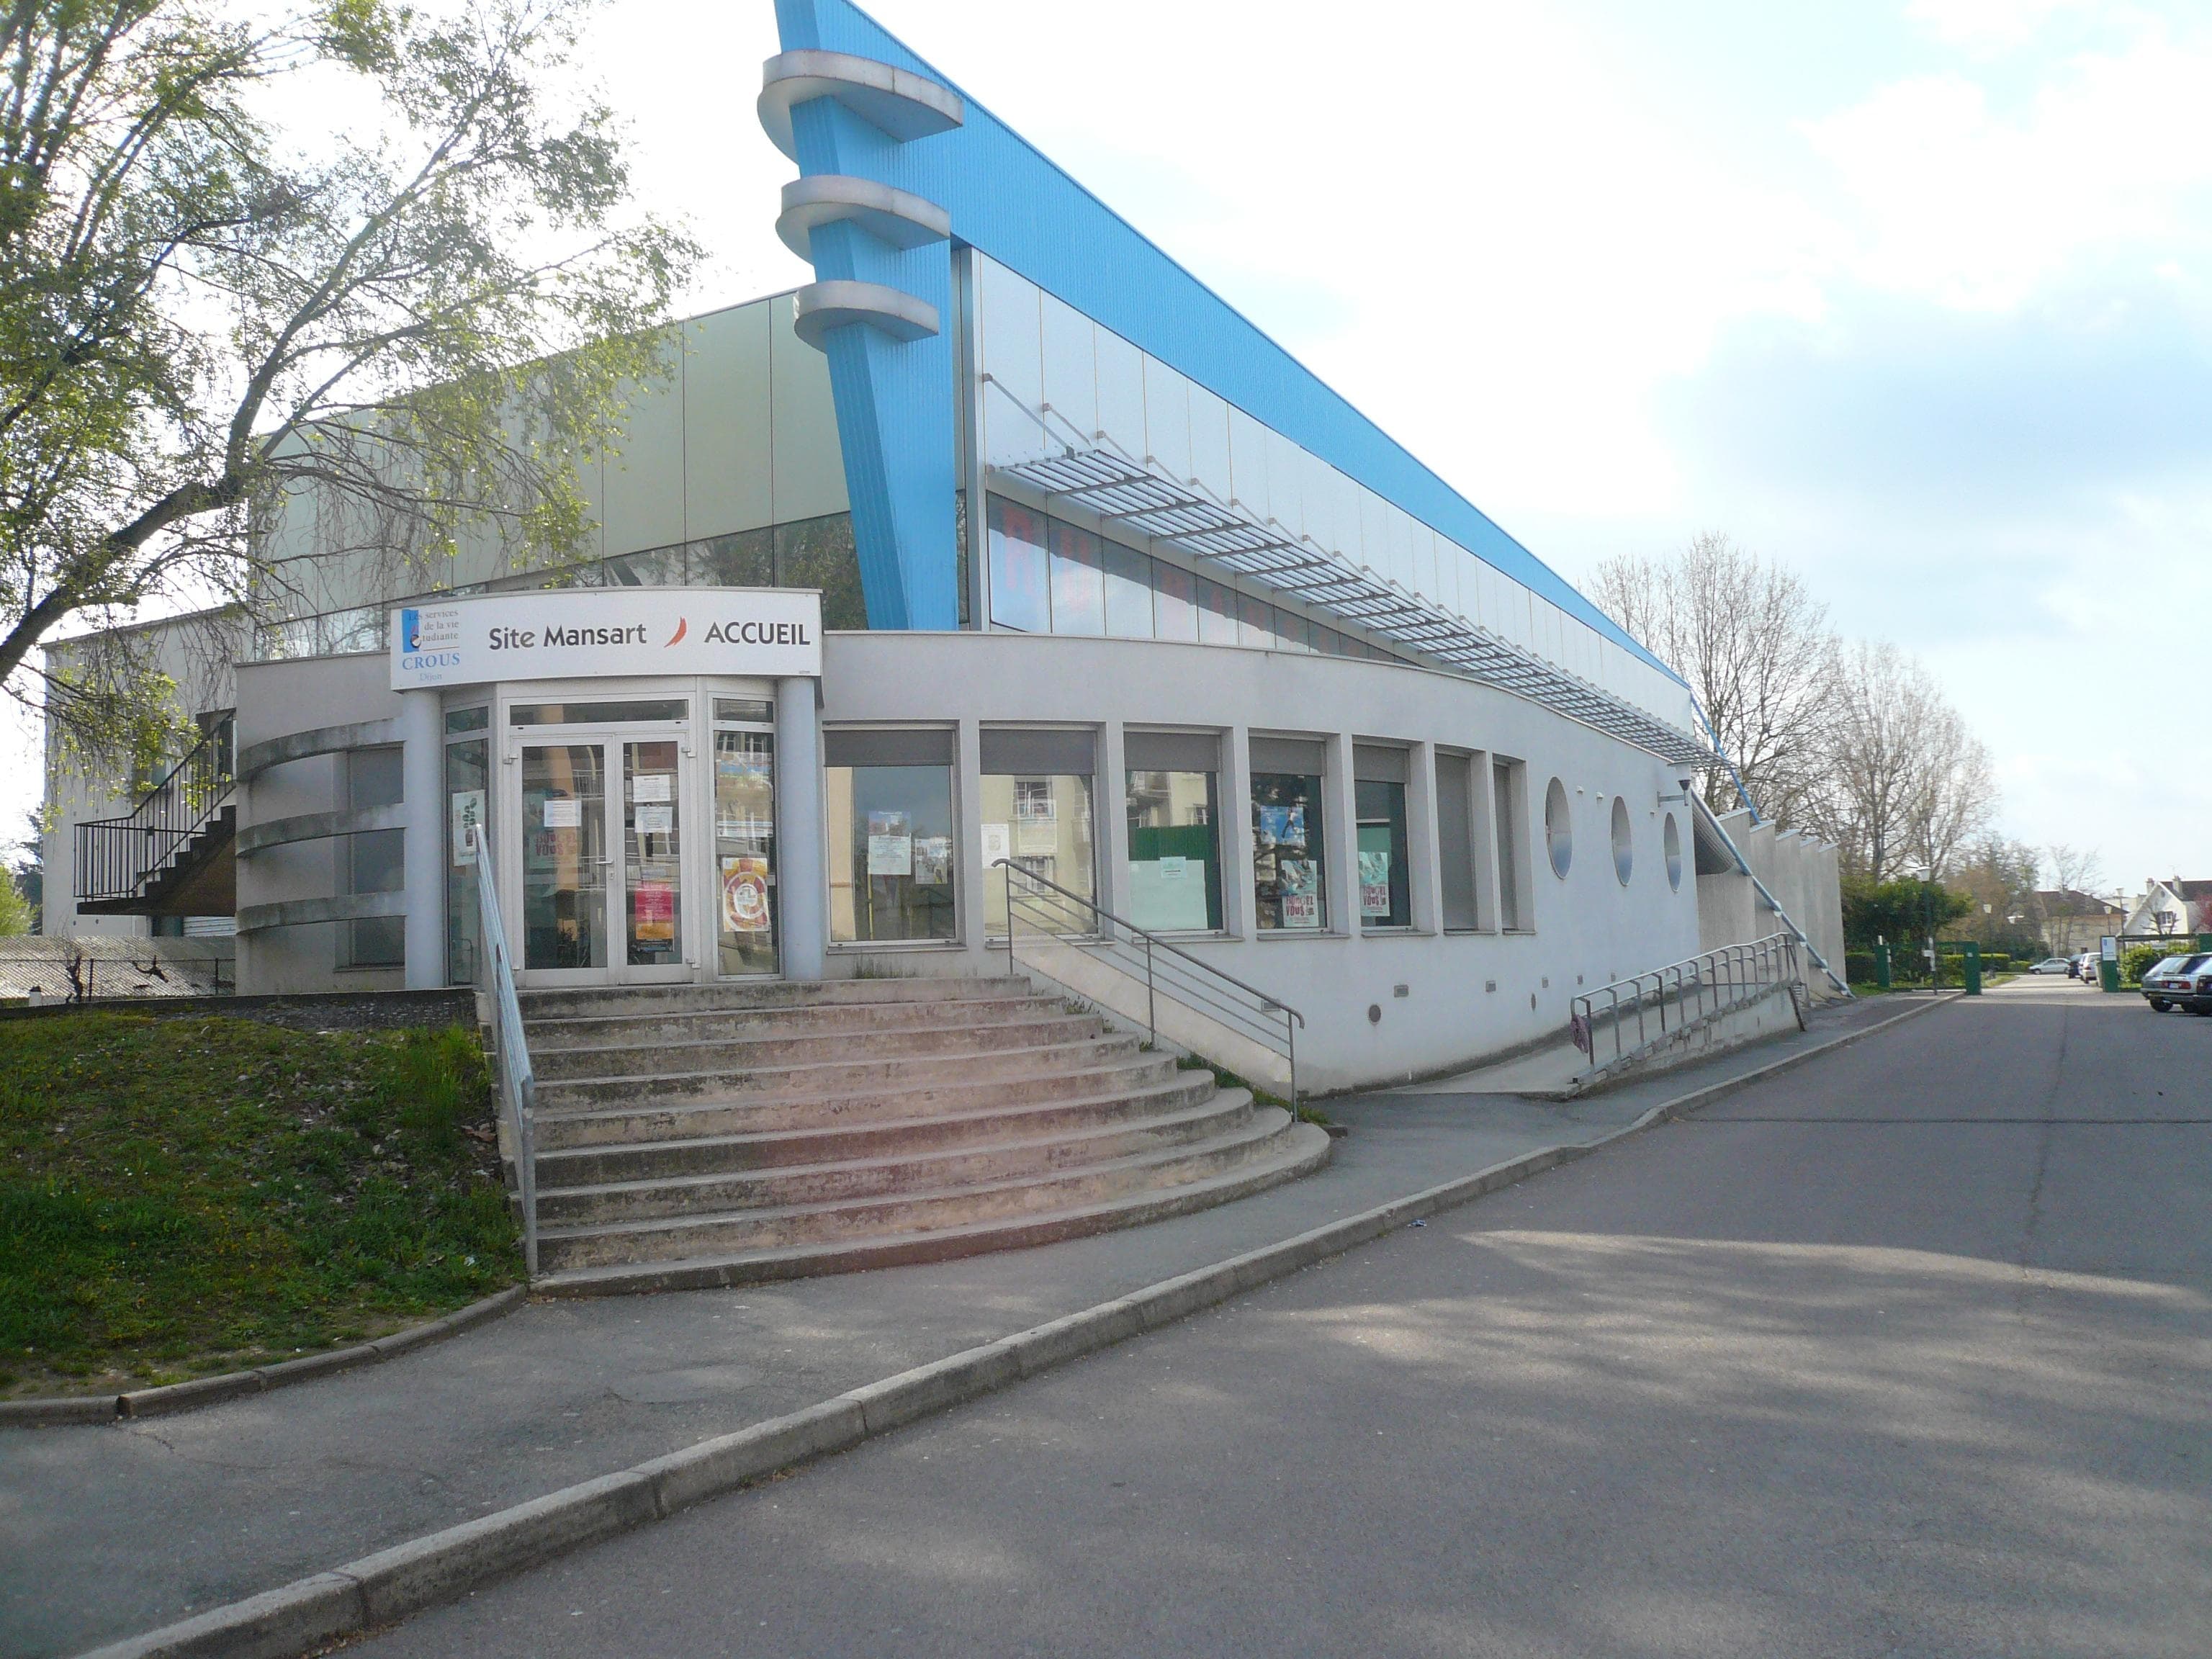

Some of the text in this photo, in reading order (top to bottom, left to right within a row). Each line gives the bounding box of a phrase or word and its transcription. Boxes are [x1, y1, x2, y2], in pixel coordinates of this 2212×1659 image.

[425, 610, 459, 619] services
[489, 624, 647, 650] Site Mansart
[703, 621, 811, 645] ACCUEIL
[403, 652, 460, 670] CROUS
[419, 673, 443, 681] Dijon
